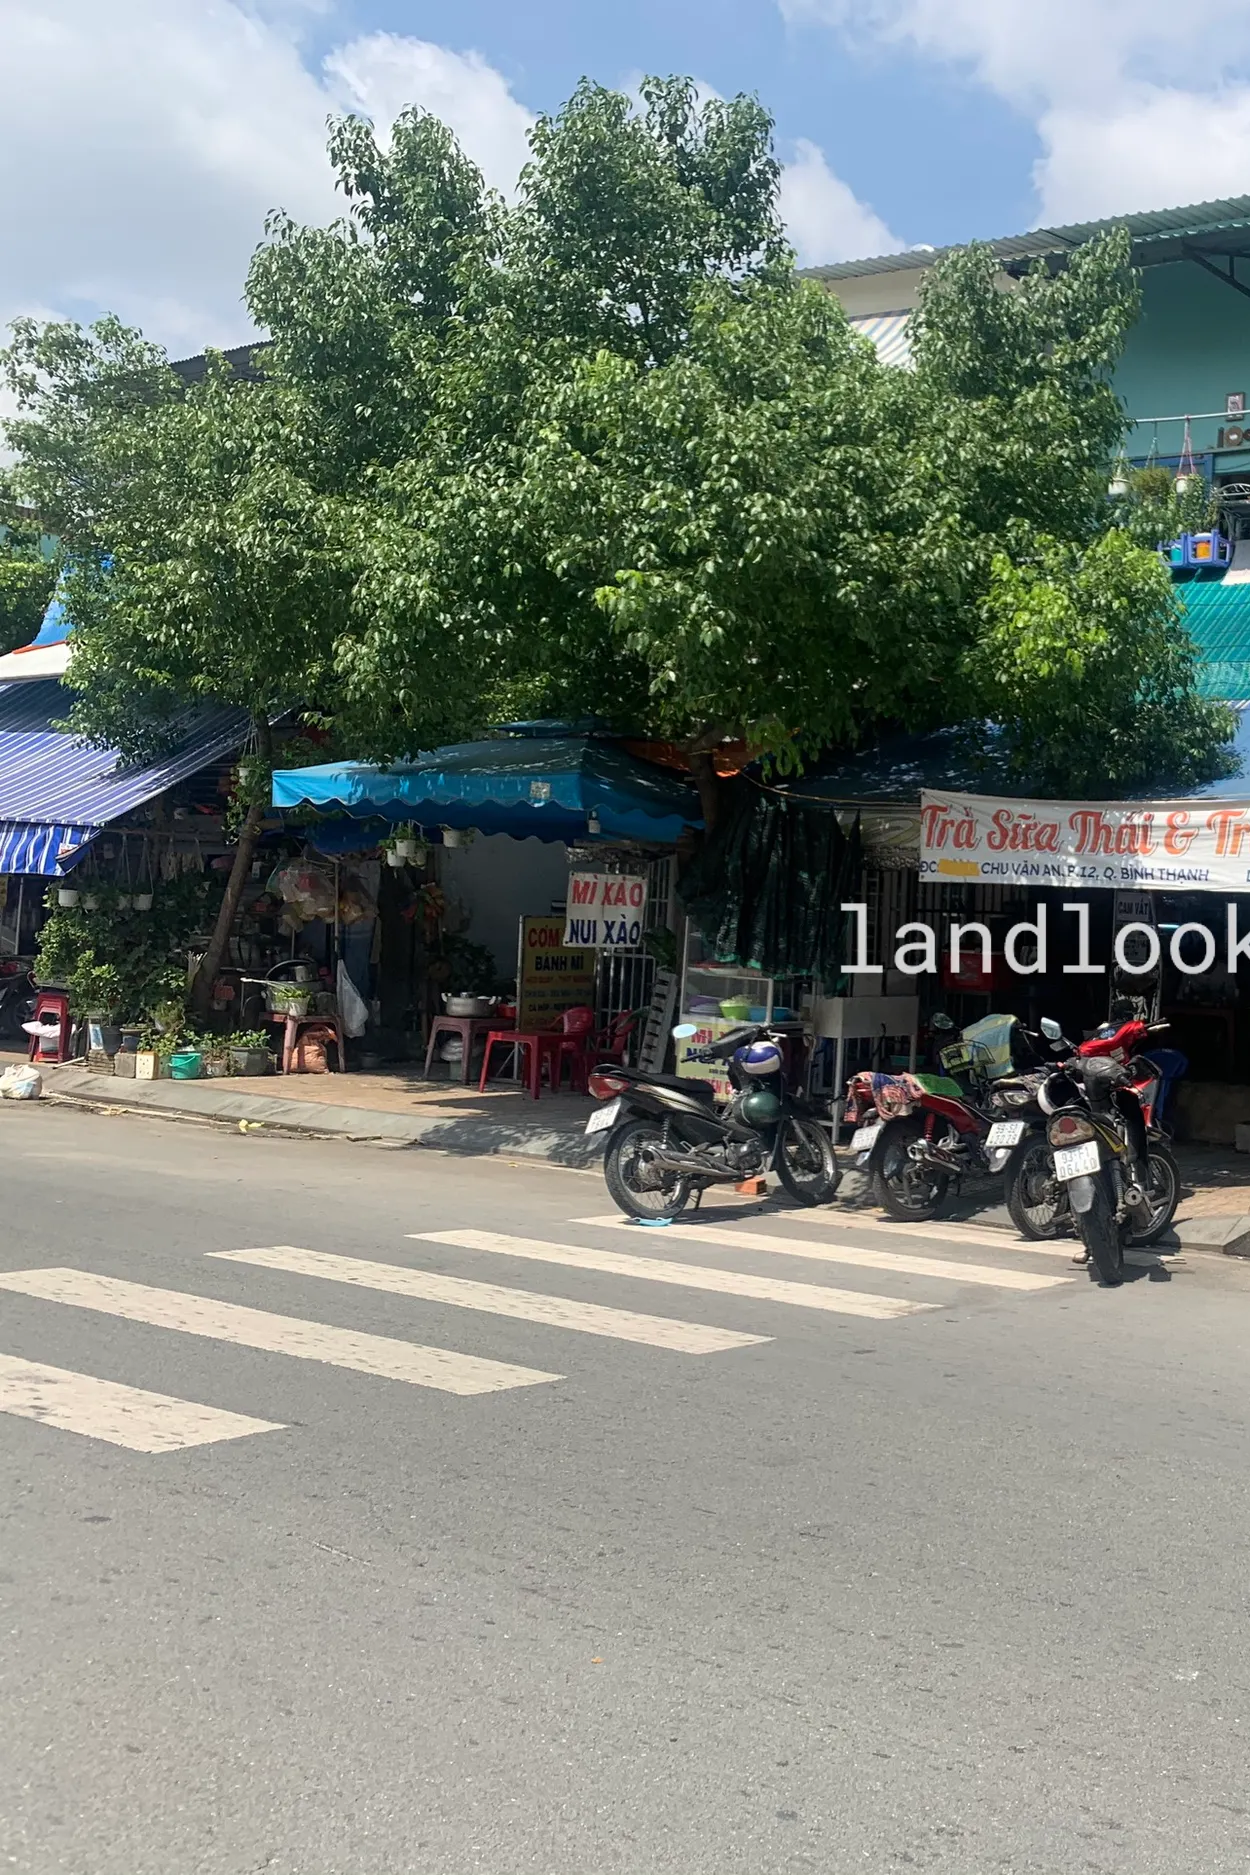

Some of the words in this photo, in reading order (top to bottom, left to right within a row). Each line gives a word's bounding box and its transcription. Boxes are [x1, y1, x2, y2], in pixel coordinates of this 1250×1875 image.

[920, 804, 980, 851] Trà
[986, 808, 1060, 854] Sữa
[1068, 808, 1156, 857] Thái
[1164, 810, 1198, 856] &
[980, 861, 1009, 875] CHU
[1012, 860, 1041, 876] VĂN
[1103, 866, 1117, 880] Q.
[1121, 866, 1155, 880] BÌNH
[1158, 867, 1209, 884] THẠNH
[571, 875, 599, 905] MÌ
[569, 918, 597, 944] NUI
[602, 914, 641, 945] XÀO
